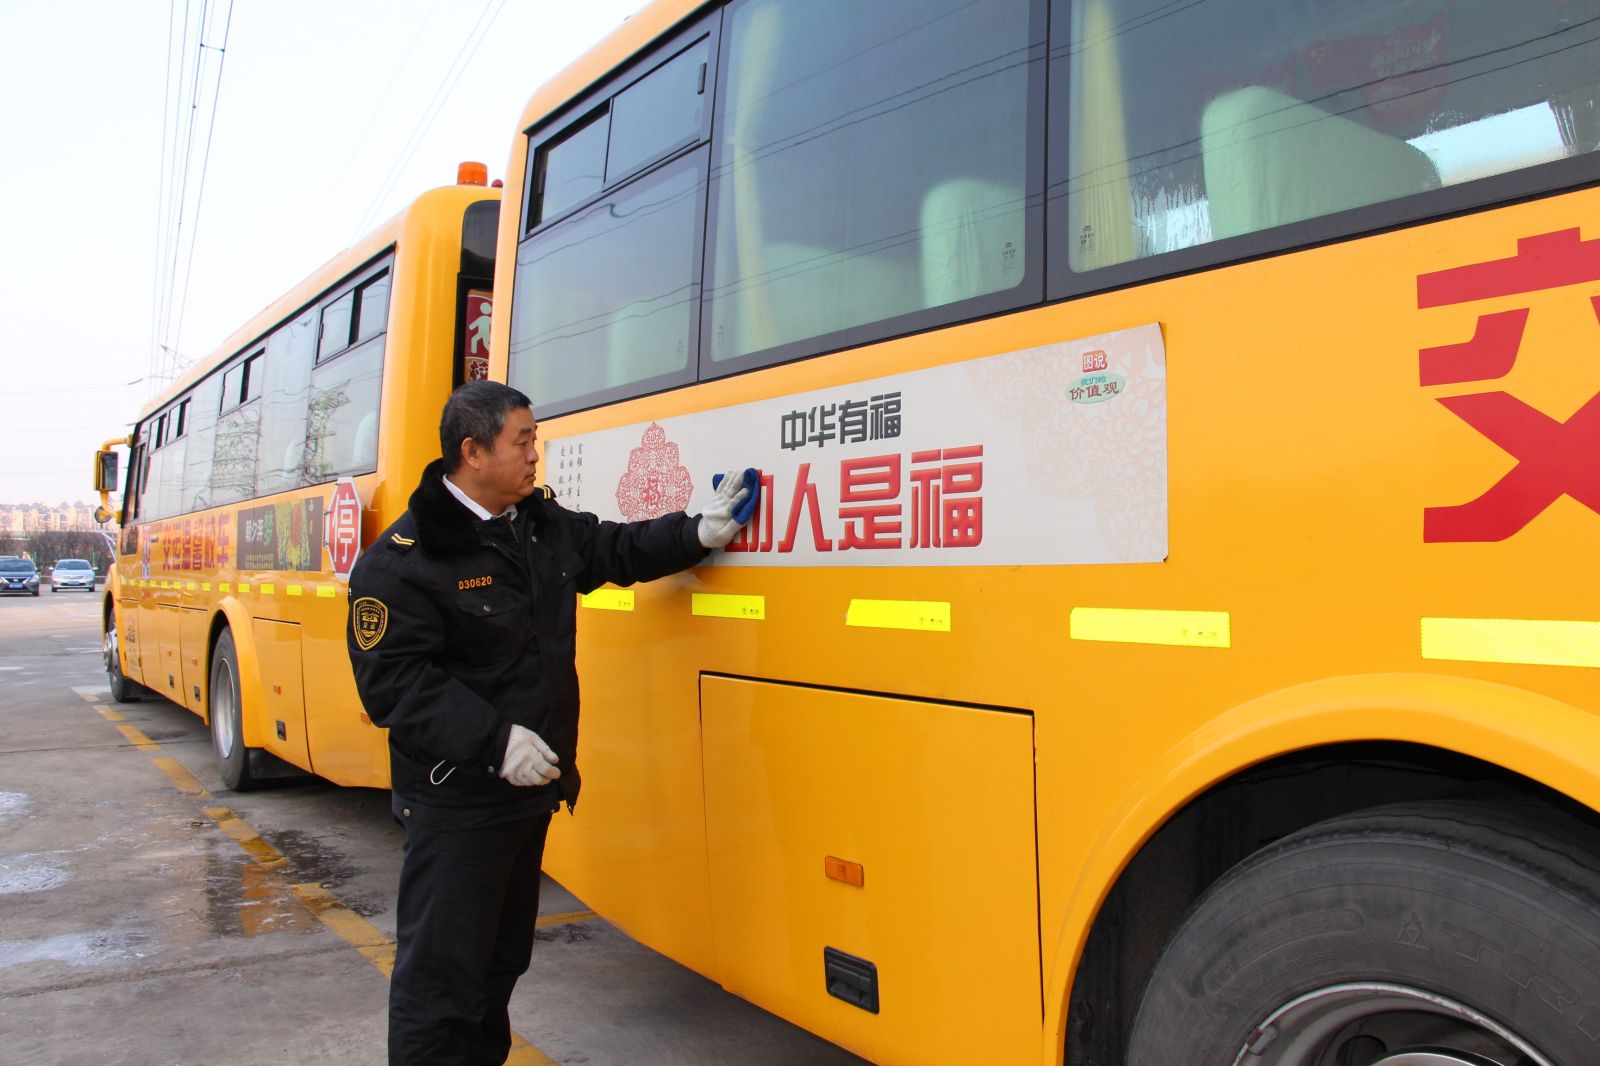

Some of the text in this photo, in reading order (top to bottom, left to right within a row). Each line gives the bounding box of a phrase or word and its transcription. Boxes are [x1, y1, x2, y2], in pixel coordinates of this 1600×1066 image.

[1083, 352, 1105, 370] 图说
[1069, 382, 1119, 400] 价值观
[781, 391, 902, 451] 中华有福
[331, 492, 355, 564] 停
[458, 575, 493, 590] D30620
